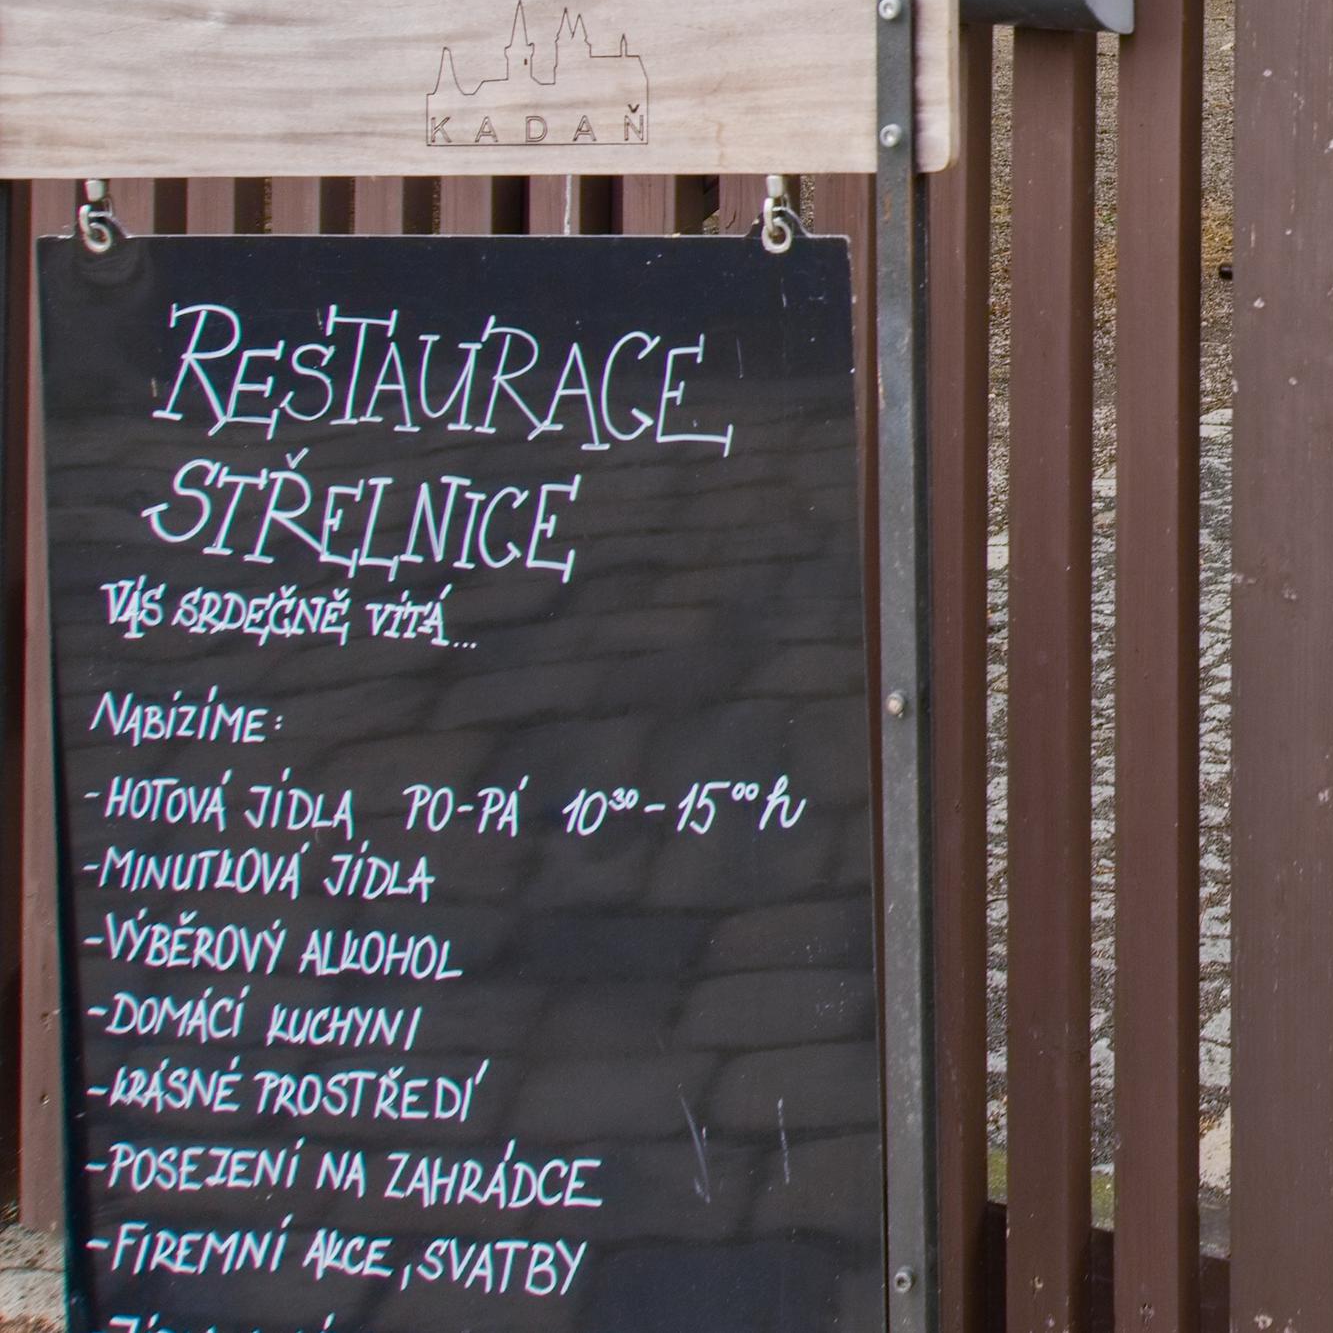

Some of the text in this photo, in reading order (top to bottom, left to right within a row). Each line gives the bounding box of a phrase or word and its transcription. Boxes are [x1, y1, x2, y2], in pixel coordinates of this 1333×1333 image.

[430, 104, 645, 144] KADAŇ
[153, 304, 733, 457] RESTAURACE
[141, 451, 581, 583] STŘELNICE
[100, 575, 166, 639] VÁS
[171, 585, 351, 646] SRDEČNĚ
[89, 685, 282, 747] NABÍZÍME:
[244, 767, 353, 835] JÍDLA
[402, 775, 529, 837] PO-PÁ
[323, 840, 435, 903] JÍDLA
[299, 929, 463, 981] ALKOHOL
[253, 1059, 489, 1122] PROSTŘEDÍ
[316, 1151, 365, 1198] NA
[384, 1139, 602, 1209] ZAHRÁDCE
